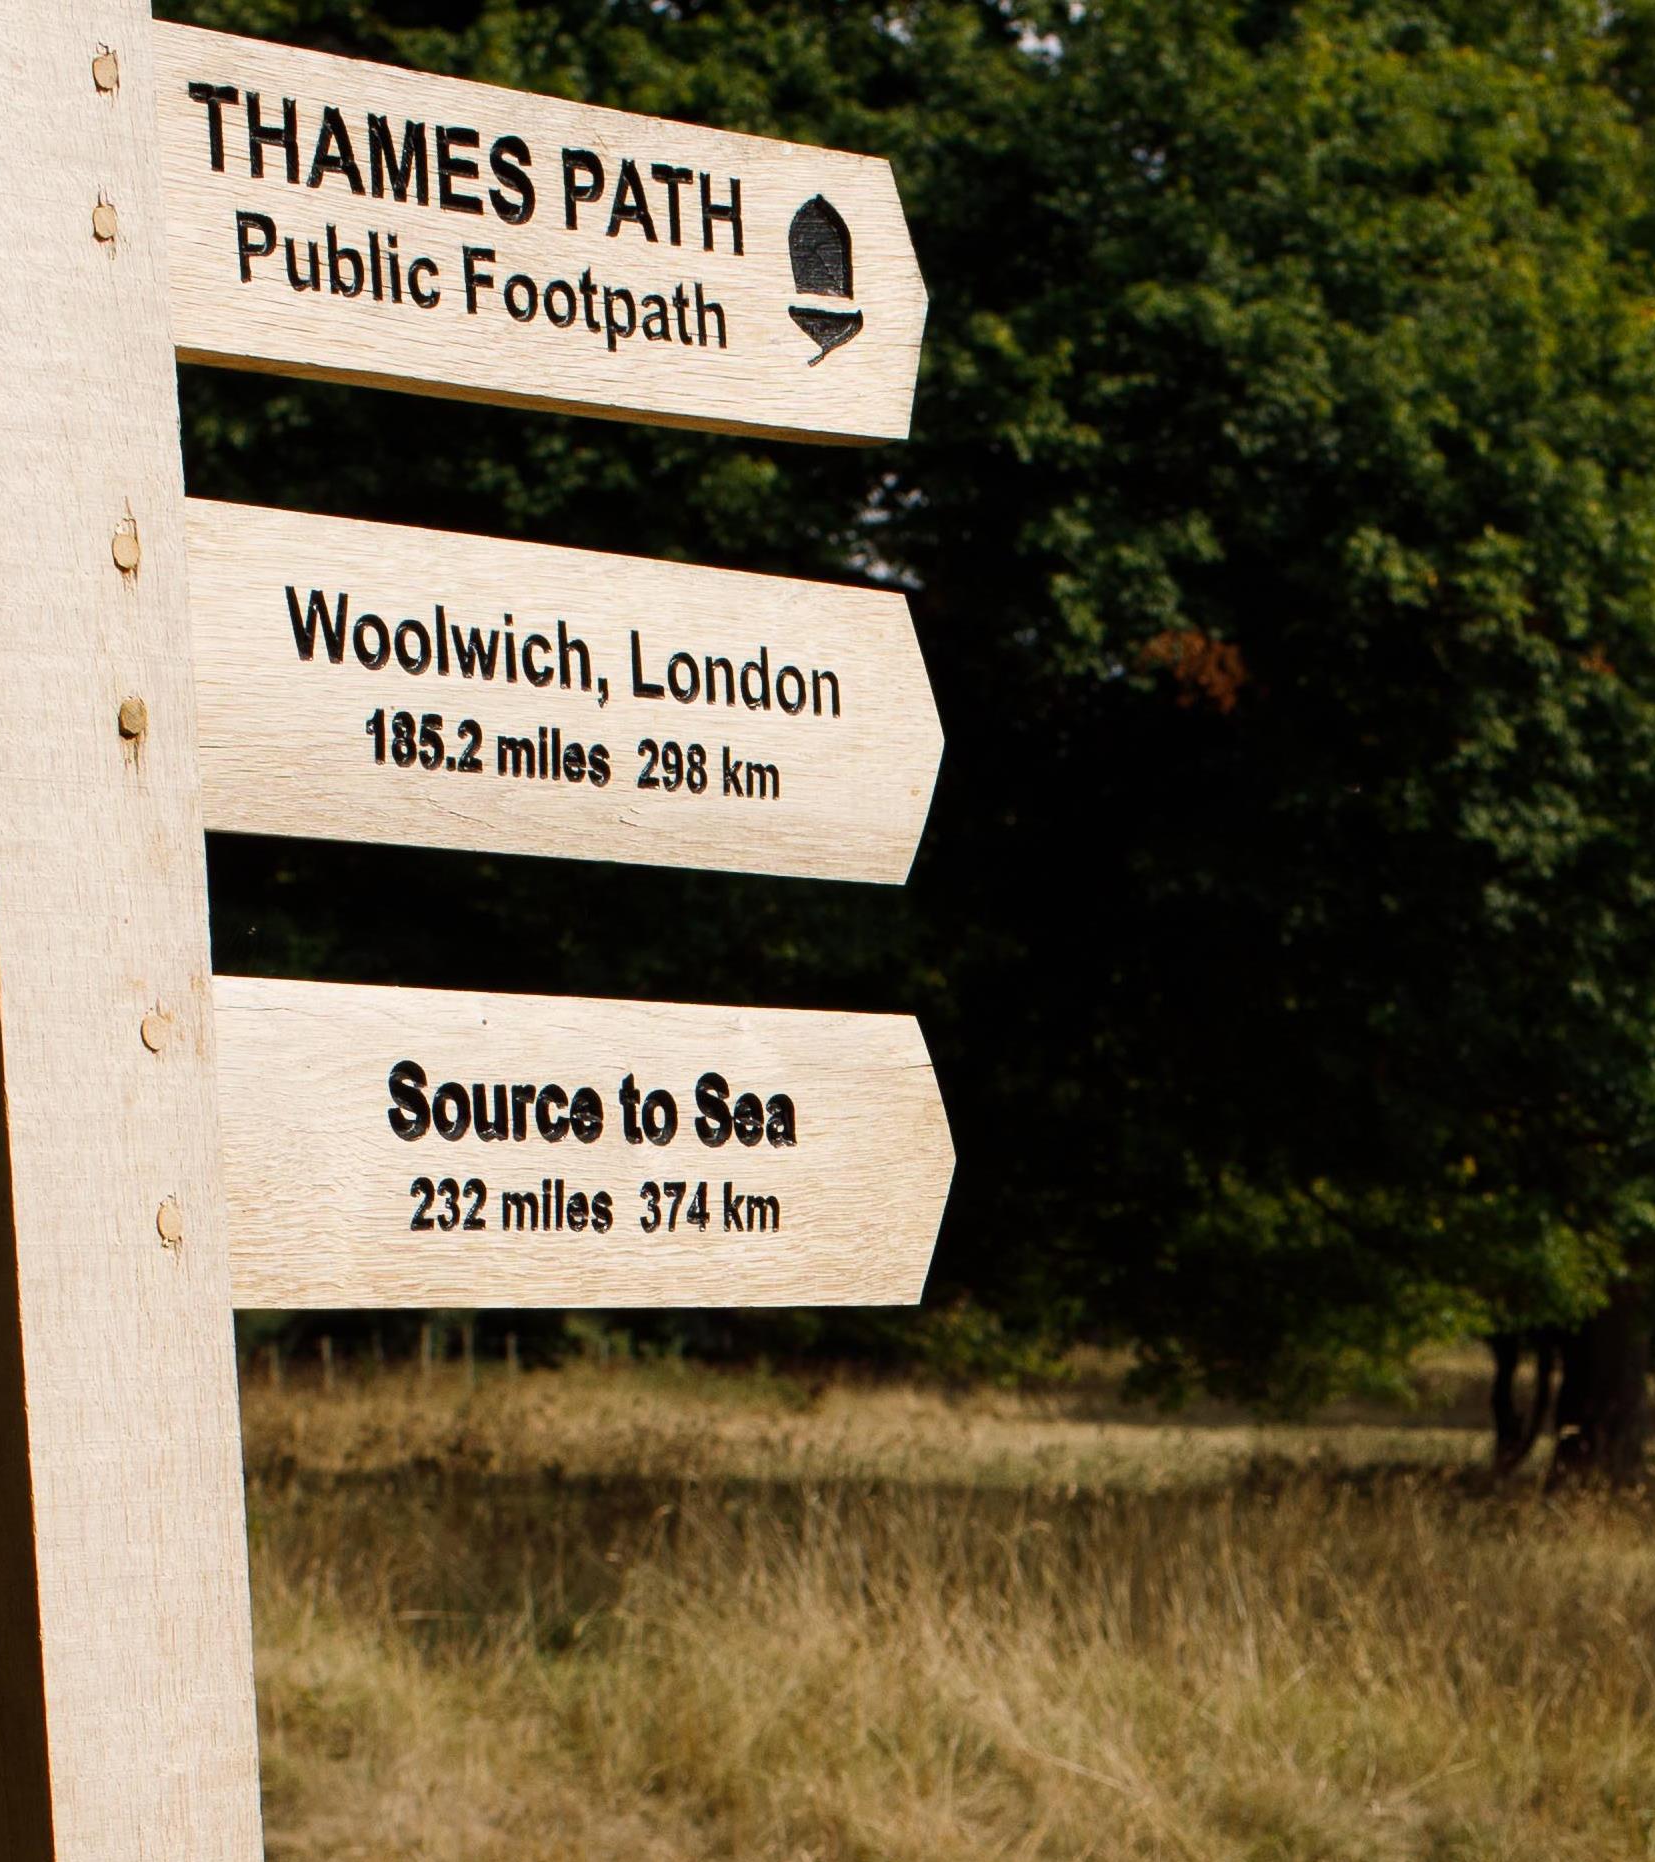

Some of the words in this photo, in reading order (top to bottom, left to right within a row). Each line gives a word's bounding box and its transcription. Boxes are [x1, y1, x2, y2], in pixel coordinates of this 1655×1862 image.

[188, 81, 536, 226] THAMES
[561, 147, 744, 257] PATH
[235, 210, 441, 309] Public
[462, 245, 727, 353] Footpath
[285, 585, 609, 708] Woolwich,
[630, 629, 841, 717] London
[365, 708, 483, 774] 185.2
[497, 726, 611, 788] miles
[637, 738, 708, 795] 298
[722, 746, 780, 800] km
[387, 1060, 604, 1144] Source
[618, 1073, 679, 1147] to
[694, 1072, 798, 1149] Sea
[410, 1176, 487, 1232] 232
[501, 1178, 614, 1234] miles
[639, 1181, 710, 1234] 374
[723, 1181, 780, 1233] km
